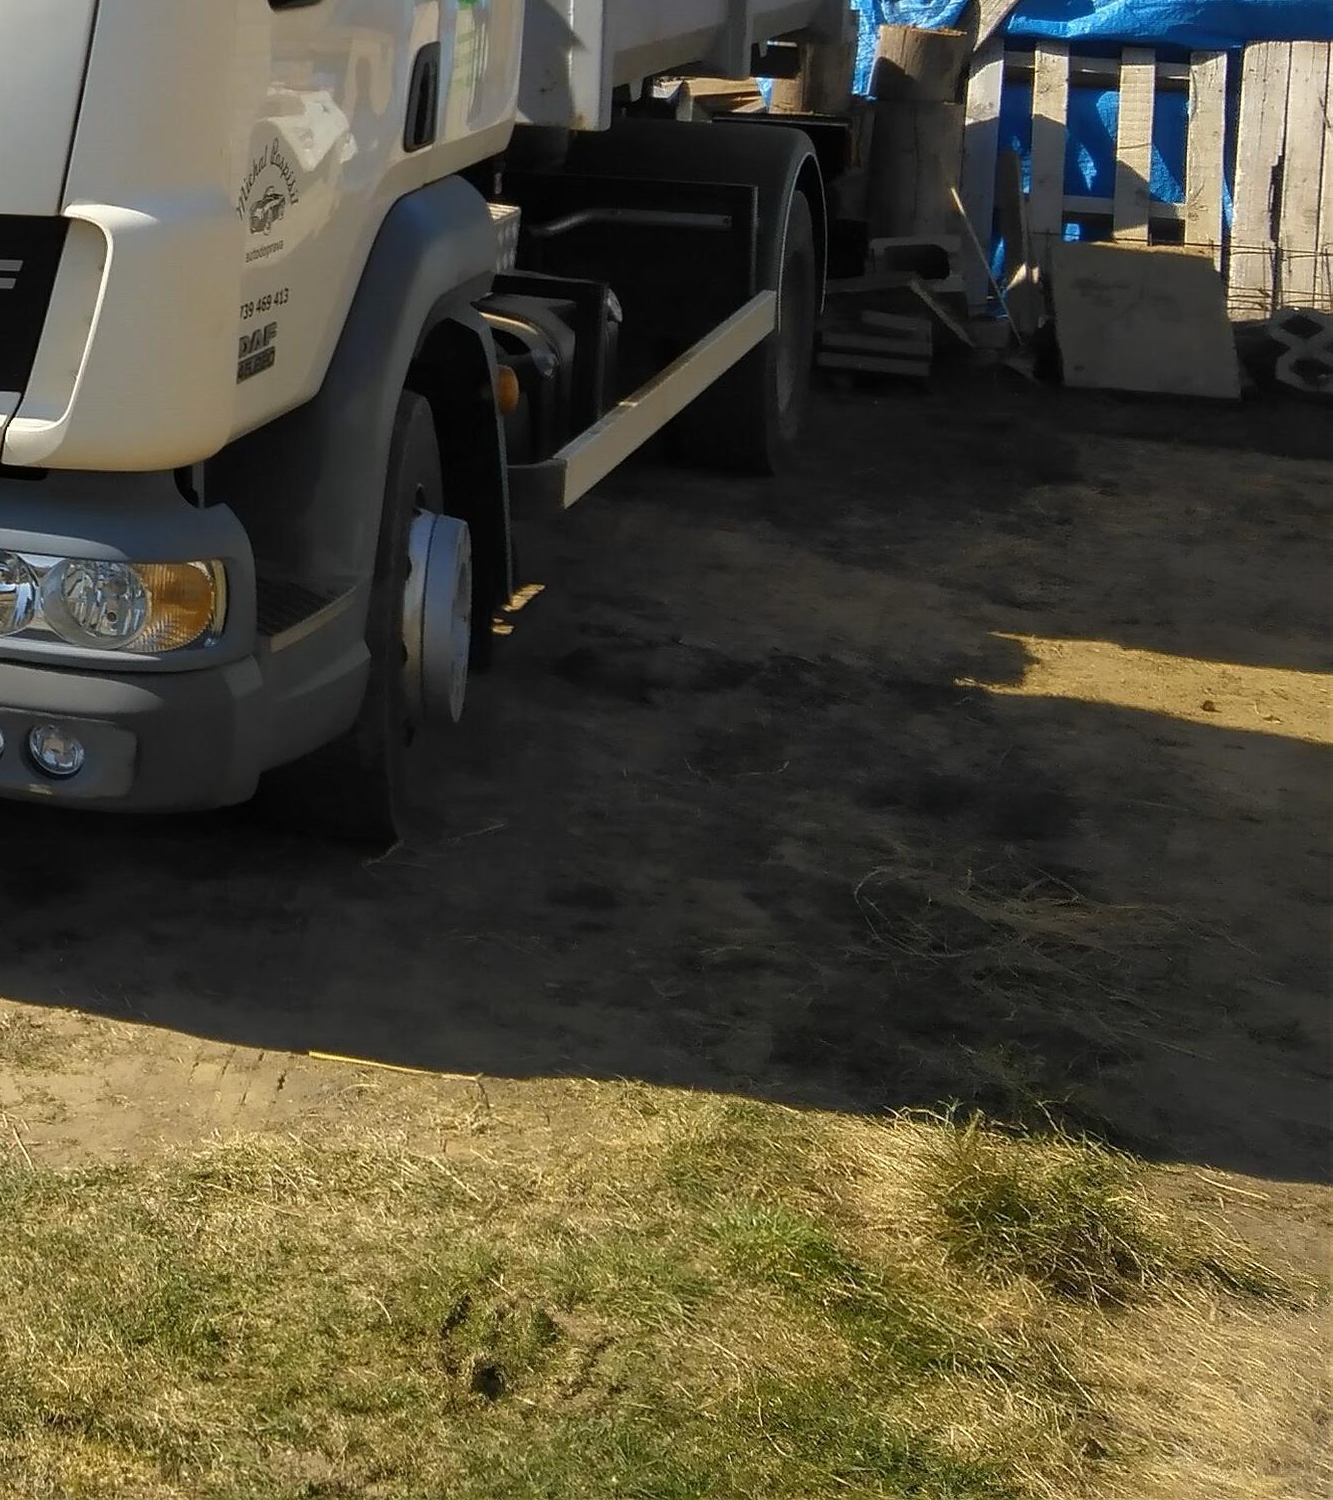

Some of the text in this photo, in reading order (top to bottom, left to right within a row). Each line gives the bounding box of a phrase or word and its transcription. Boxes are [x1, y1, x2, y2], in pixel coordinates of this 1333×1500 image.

[239, 287, 289, 320] 739 469 413
[238, 321, 278, 359] DAF
